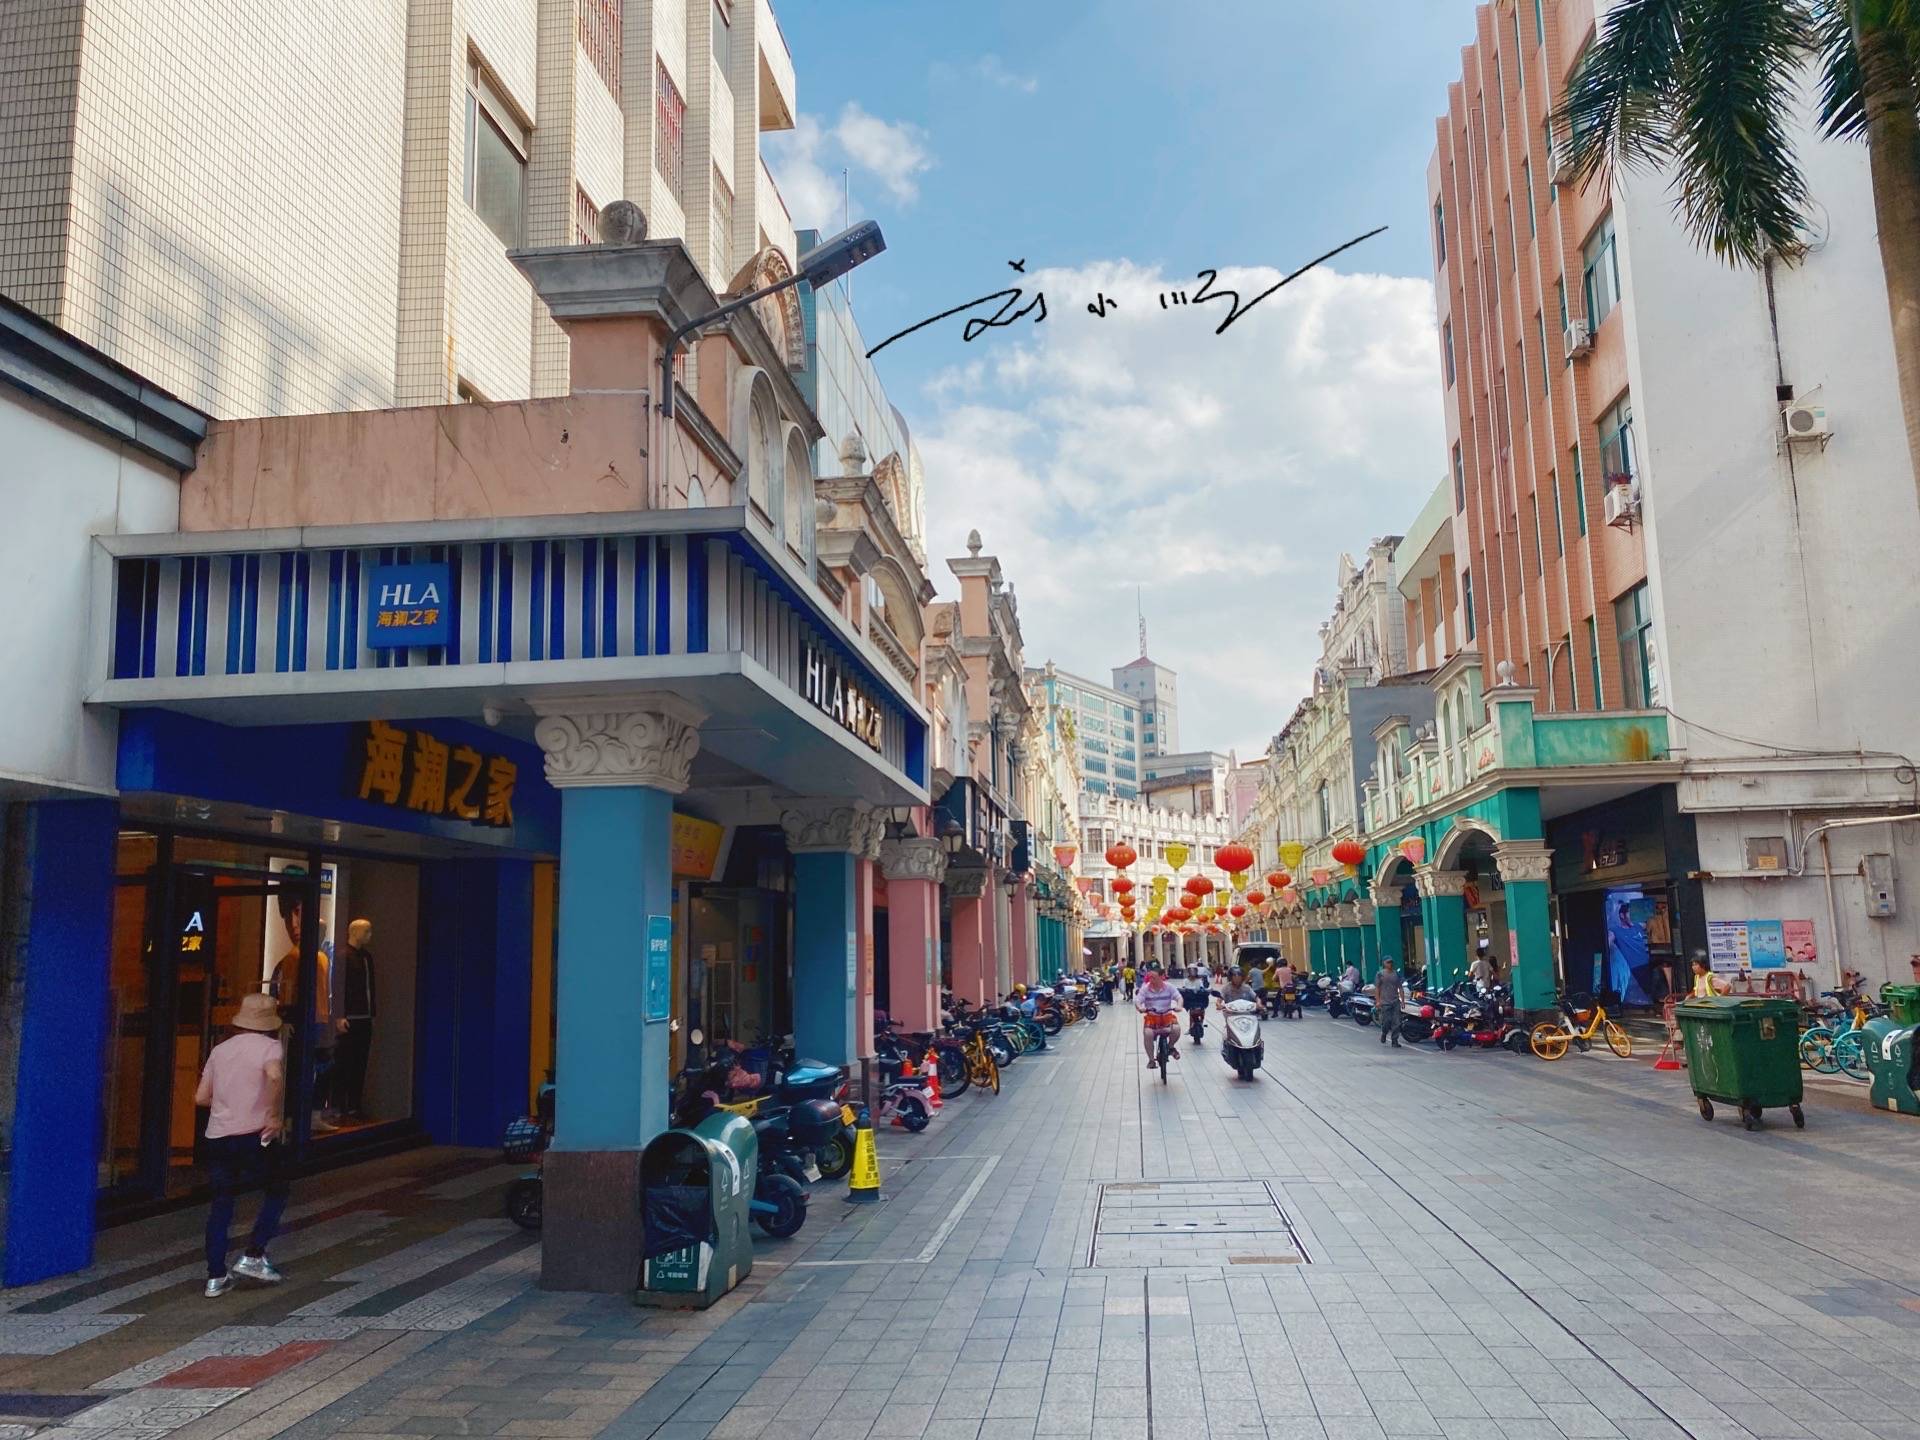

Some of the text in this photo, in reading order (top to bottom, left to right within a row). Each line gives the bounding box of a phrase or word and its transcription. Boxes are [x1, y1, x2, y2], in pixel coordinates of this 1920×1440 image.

[376, 608, 440, 628] 海澜之家
[380, 582, 440, 606] HLA
[805, 647, 844, 725] HLA
[359, 717, 517, 826] 海澜之家
